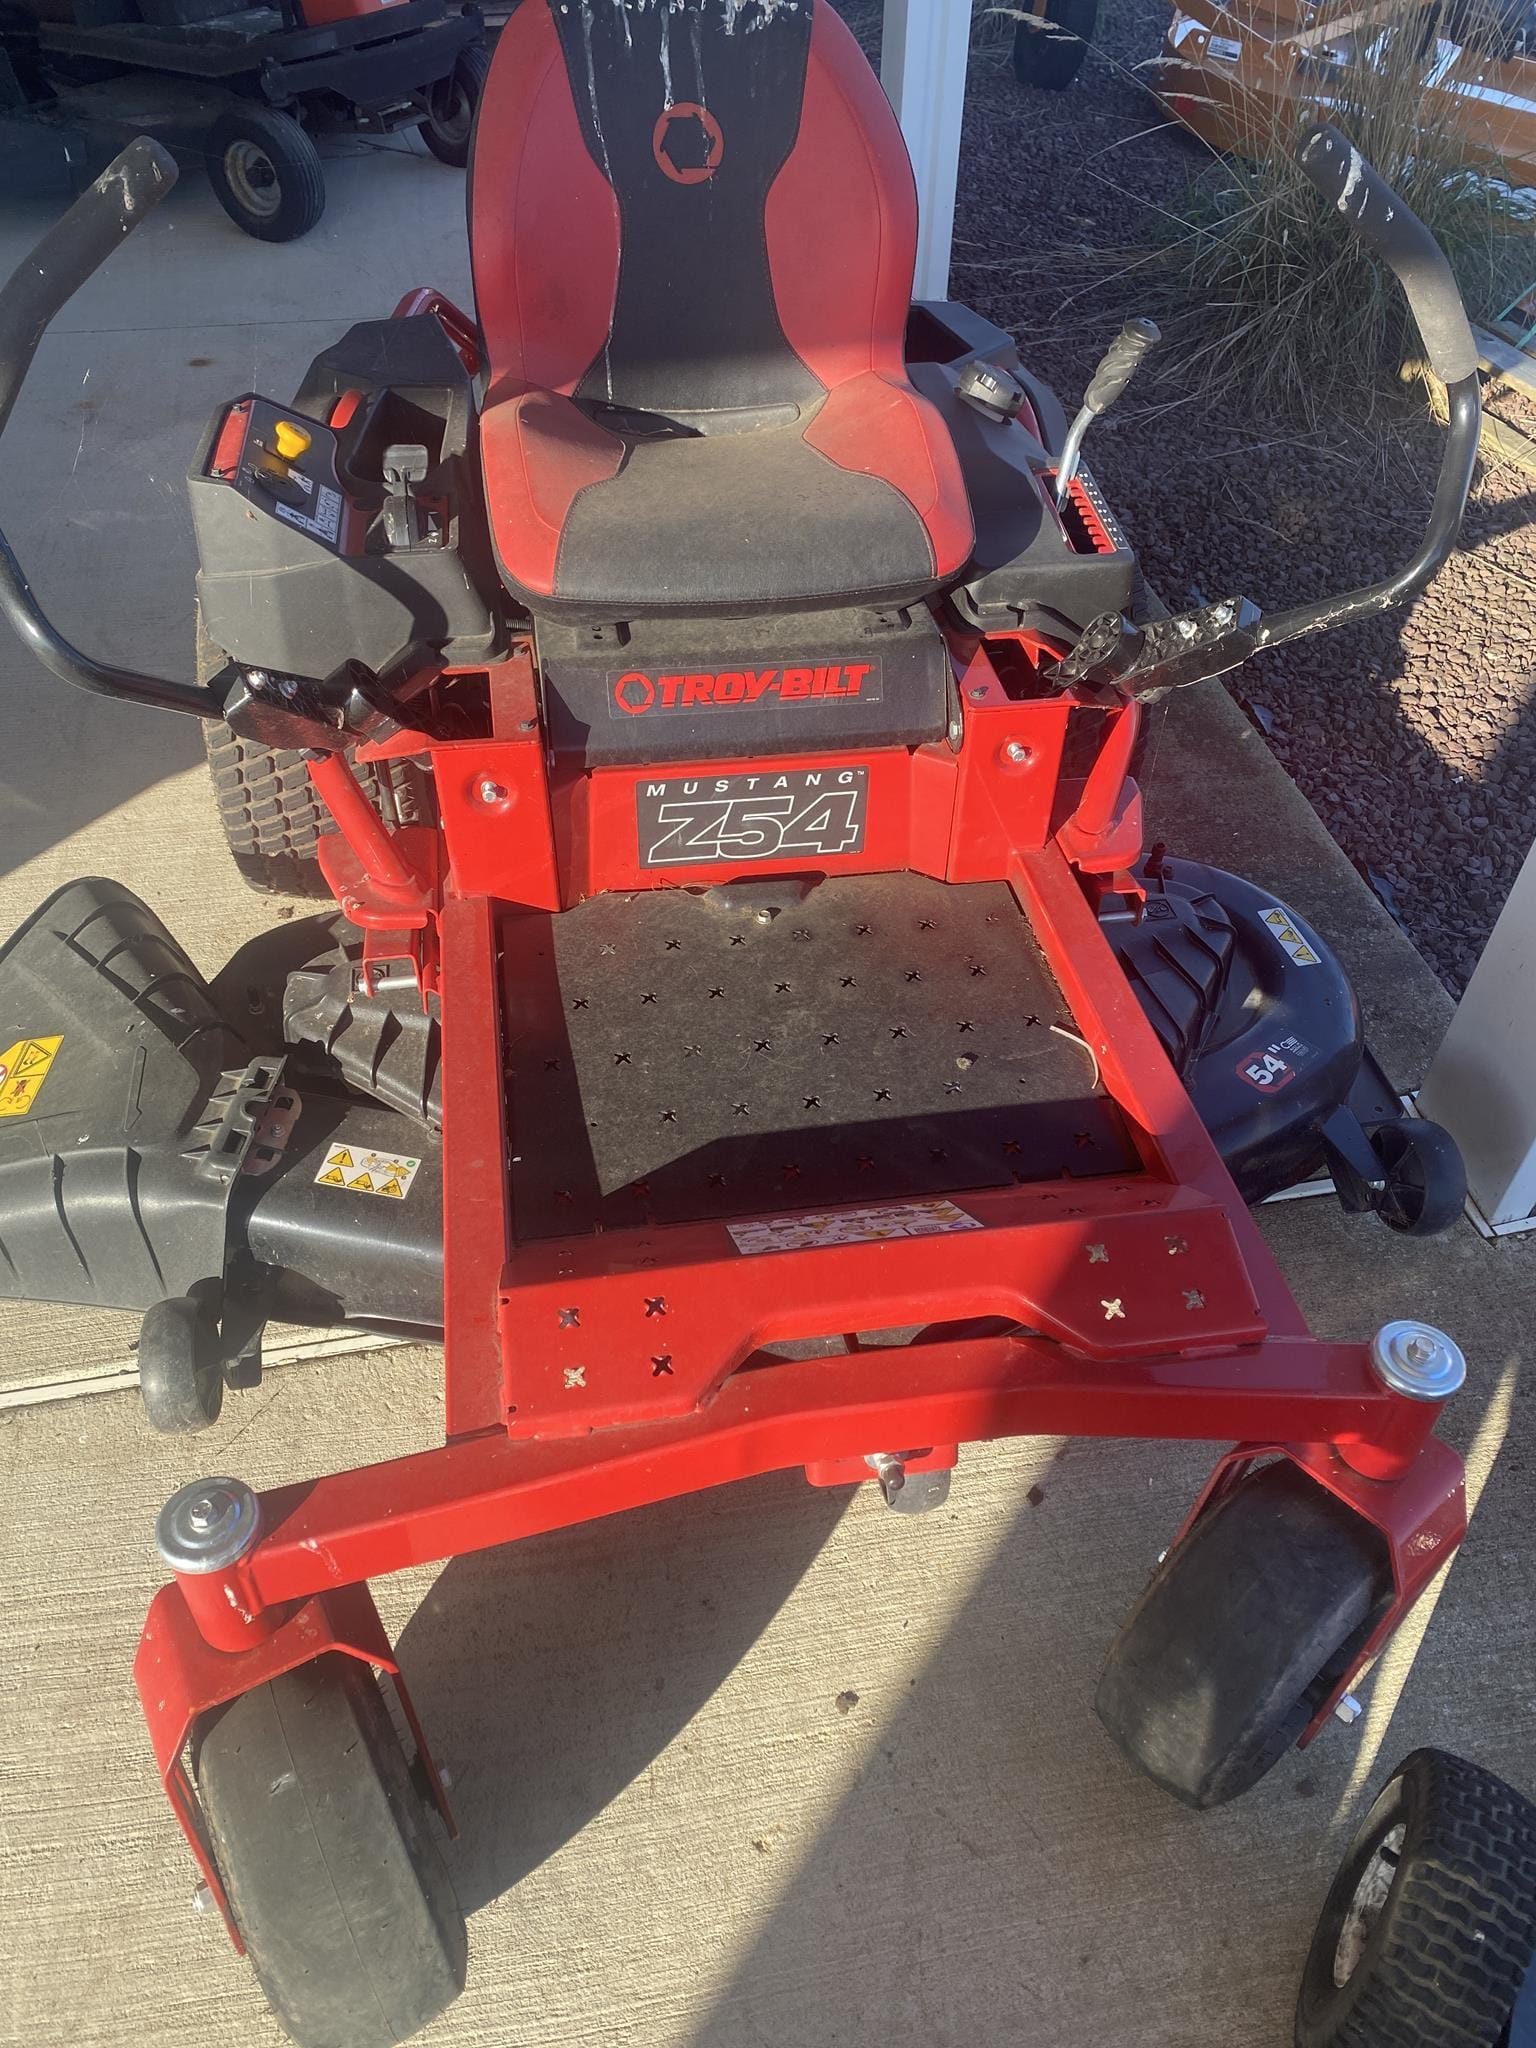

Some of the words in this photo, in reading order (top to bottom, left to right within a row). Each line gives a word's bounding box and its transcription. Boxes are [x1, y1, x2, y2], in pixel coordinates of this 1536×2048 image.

[657, 663, 871, 709] TROY-BILT
[646, 772, 854, 797] MUSTANG
[647, 790, 859, 864] Z54
